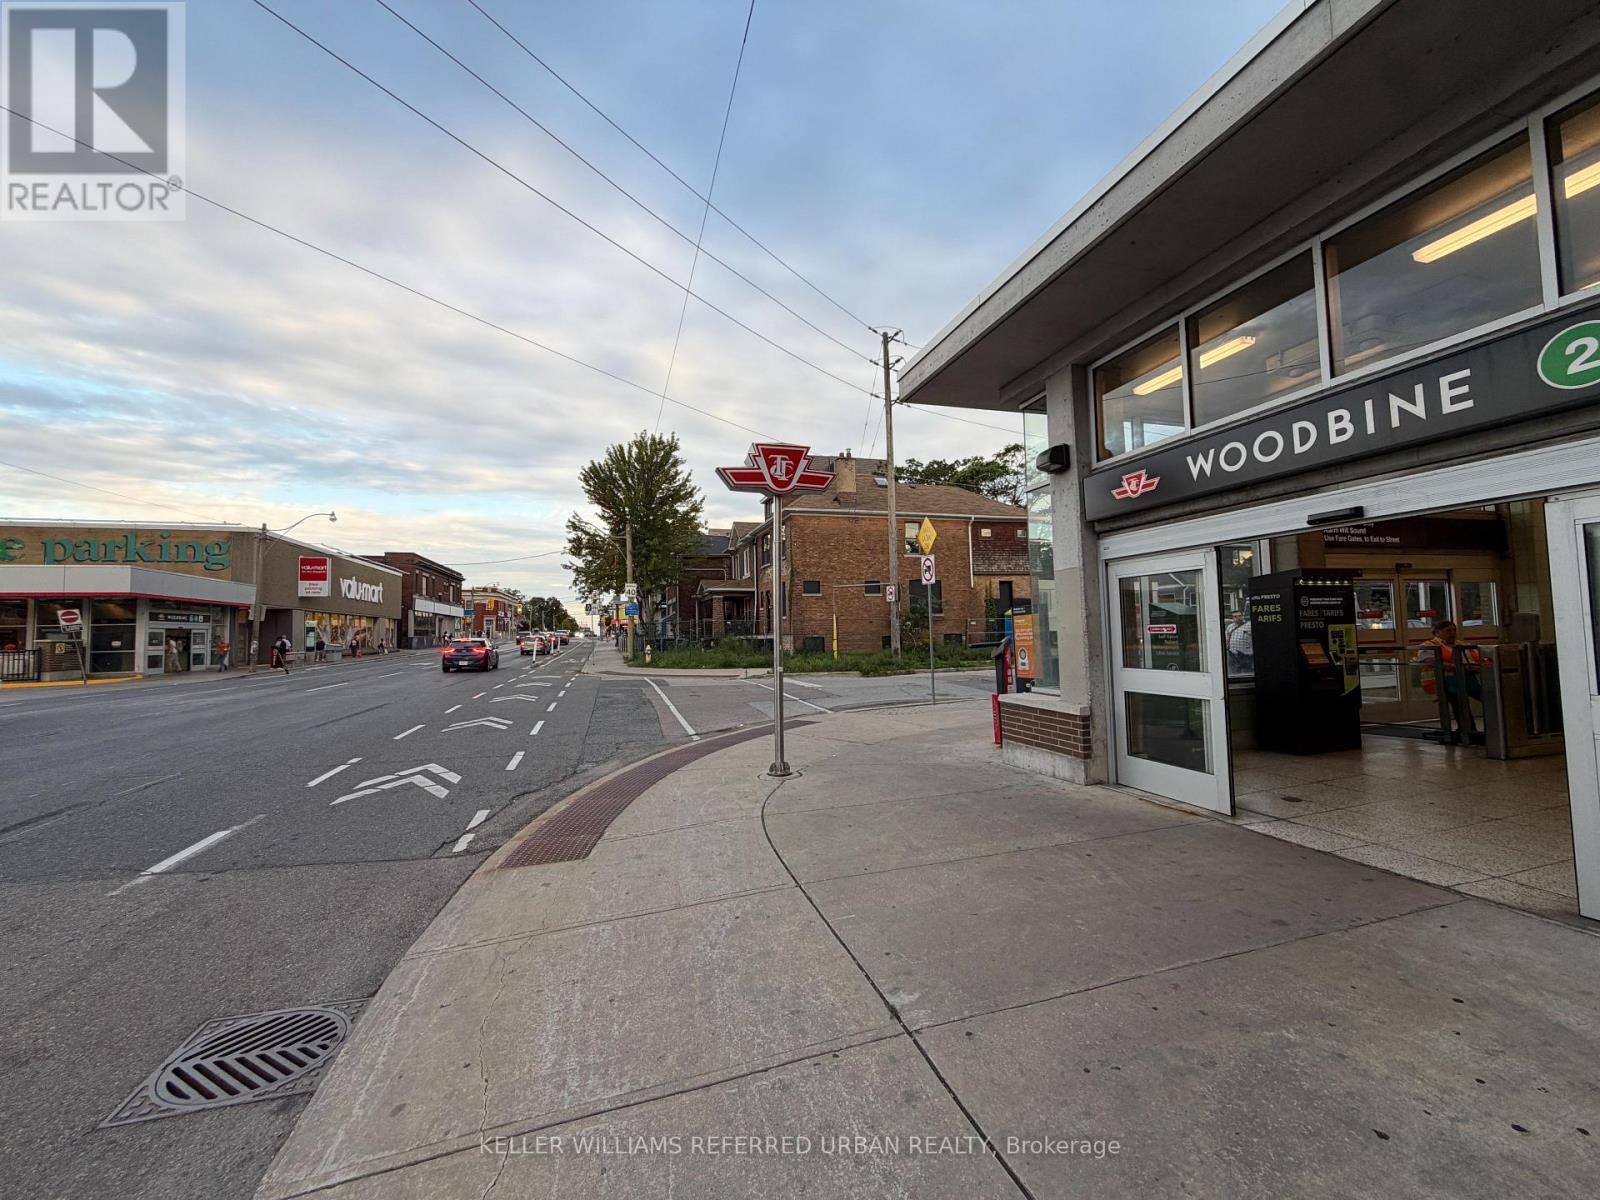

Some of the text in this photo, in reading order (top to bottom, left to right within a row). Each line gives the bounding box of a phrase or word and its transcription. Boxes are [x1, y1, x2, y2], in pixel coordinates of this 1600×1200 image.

[1565, 336, 1600, 376] 2
[1186, 369, 1474, 482] WOODBINE
[1350, 527, 1367, 535] Sound
[42, 528, 232, 571] parking
[1252, 603, 1281, 613] FARES
[1300, 621, 1325, 629] PRESTO
